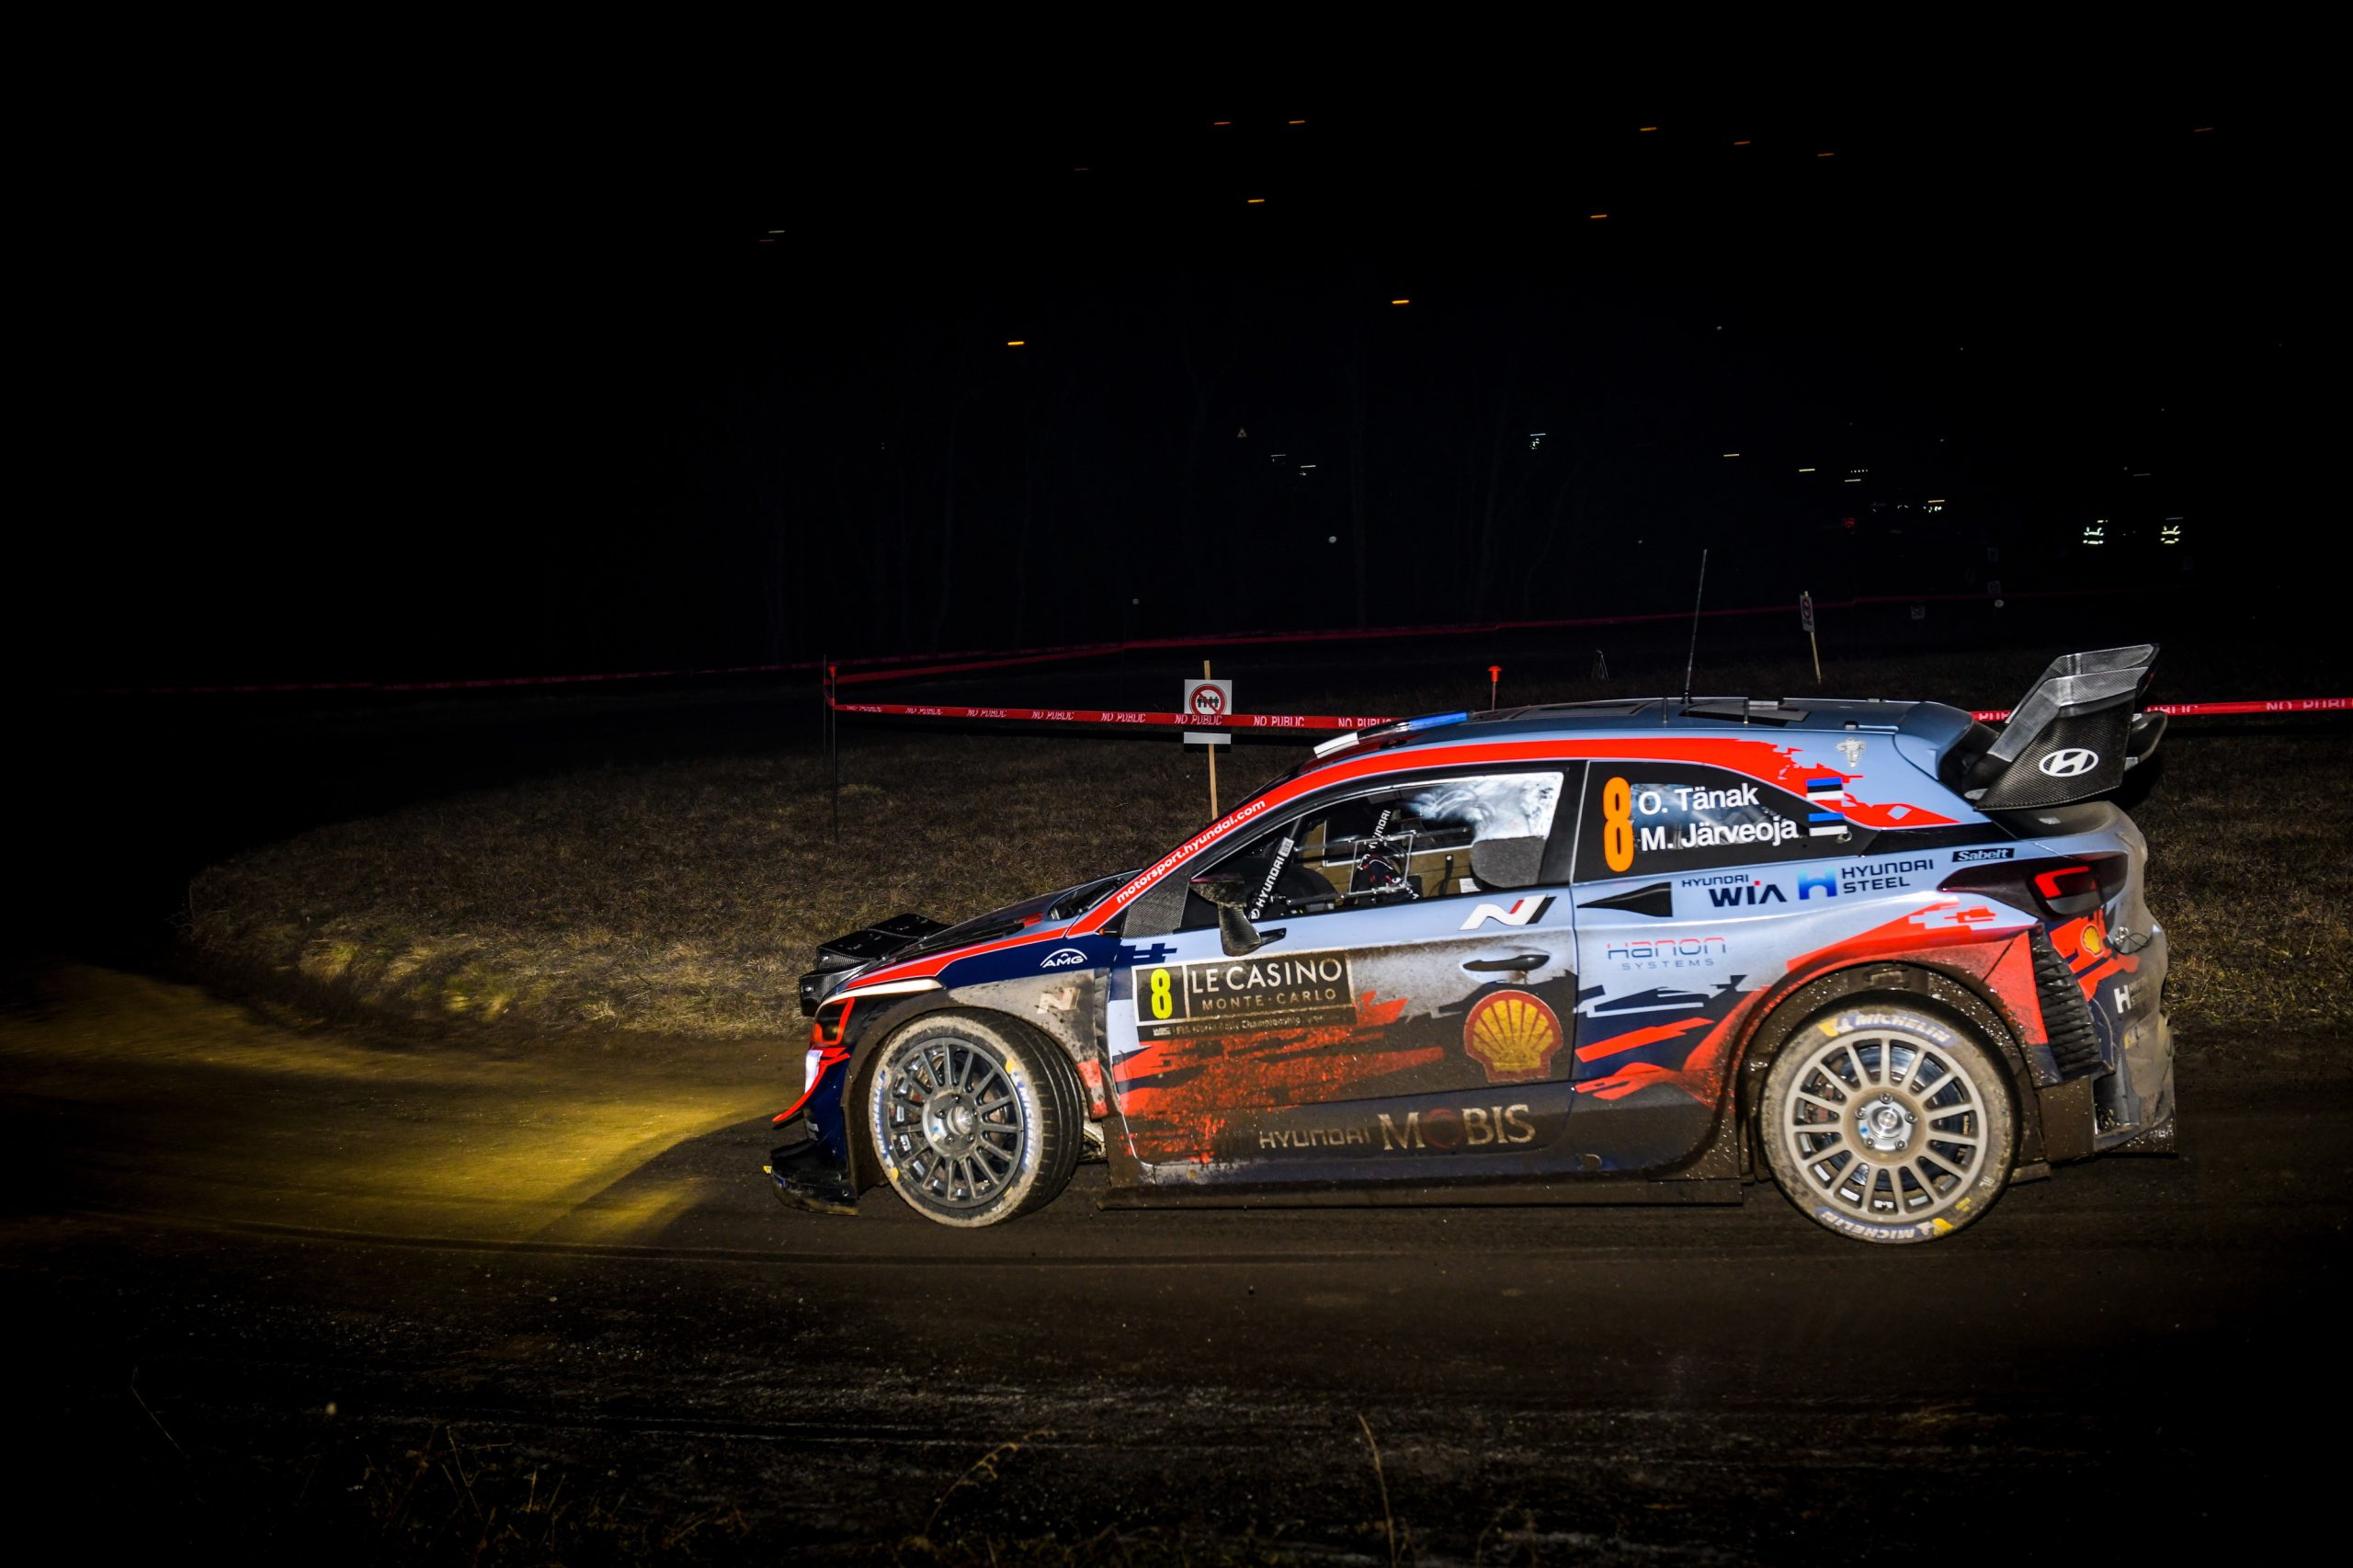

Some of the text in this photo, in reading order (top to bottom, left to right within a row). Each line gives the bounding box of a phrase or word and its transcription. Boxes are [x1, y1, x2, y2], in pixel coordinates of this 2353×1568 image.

[1100, 711, 1146, 723] NO PUBLIC
[1175, 714, 1222, 725] NO PUBLIC
[1253, 715, 1305, 727] NO PUBLIC
[1338, 717, 1353, 728] NO
[1638, 782, 1760, 815] O. Tänak
[1603, 776, 1635, 872] 8
[1641, 815, 1800, 852] M. Järveoja
[1116, 800, 1267, 904] motorsport.hyundai.com
[1956, 847, 2009, 861] Sabelt
[1682, 874, 1749, 888] HYUNDAI
[1842, 858, 1934, 880] HYUNDAI
[1256, 856, 1285, 908] HYUNDAI
[1843, 876, 1911, 893] STEEL
[1042, 953, 1084, 968] AMG
[1621, 958, 1714, 971] SYSTEMS
[1191, 958, 1343, 994] LE CASINO
[1150, 968, 1173, 1019] 8
[1855, 1014, 1951, 1042] MICHELIN
[1259, 1104, 1537, 1151] HYUNDAI MOBIS
[1820, 1210, 1916, 1240] MICHELIN
